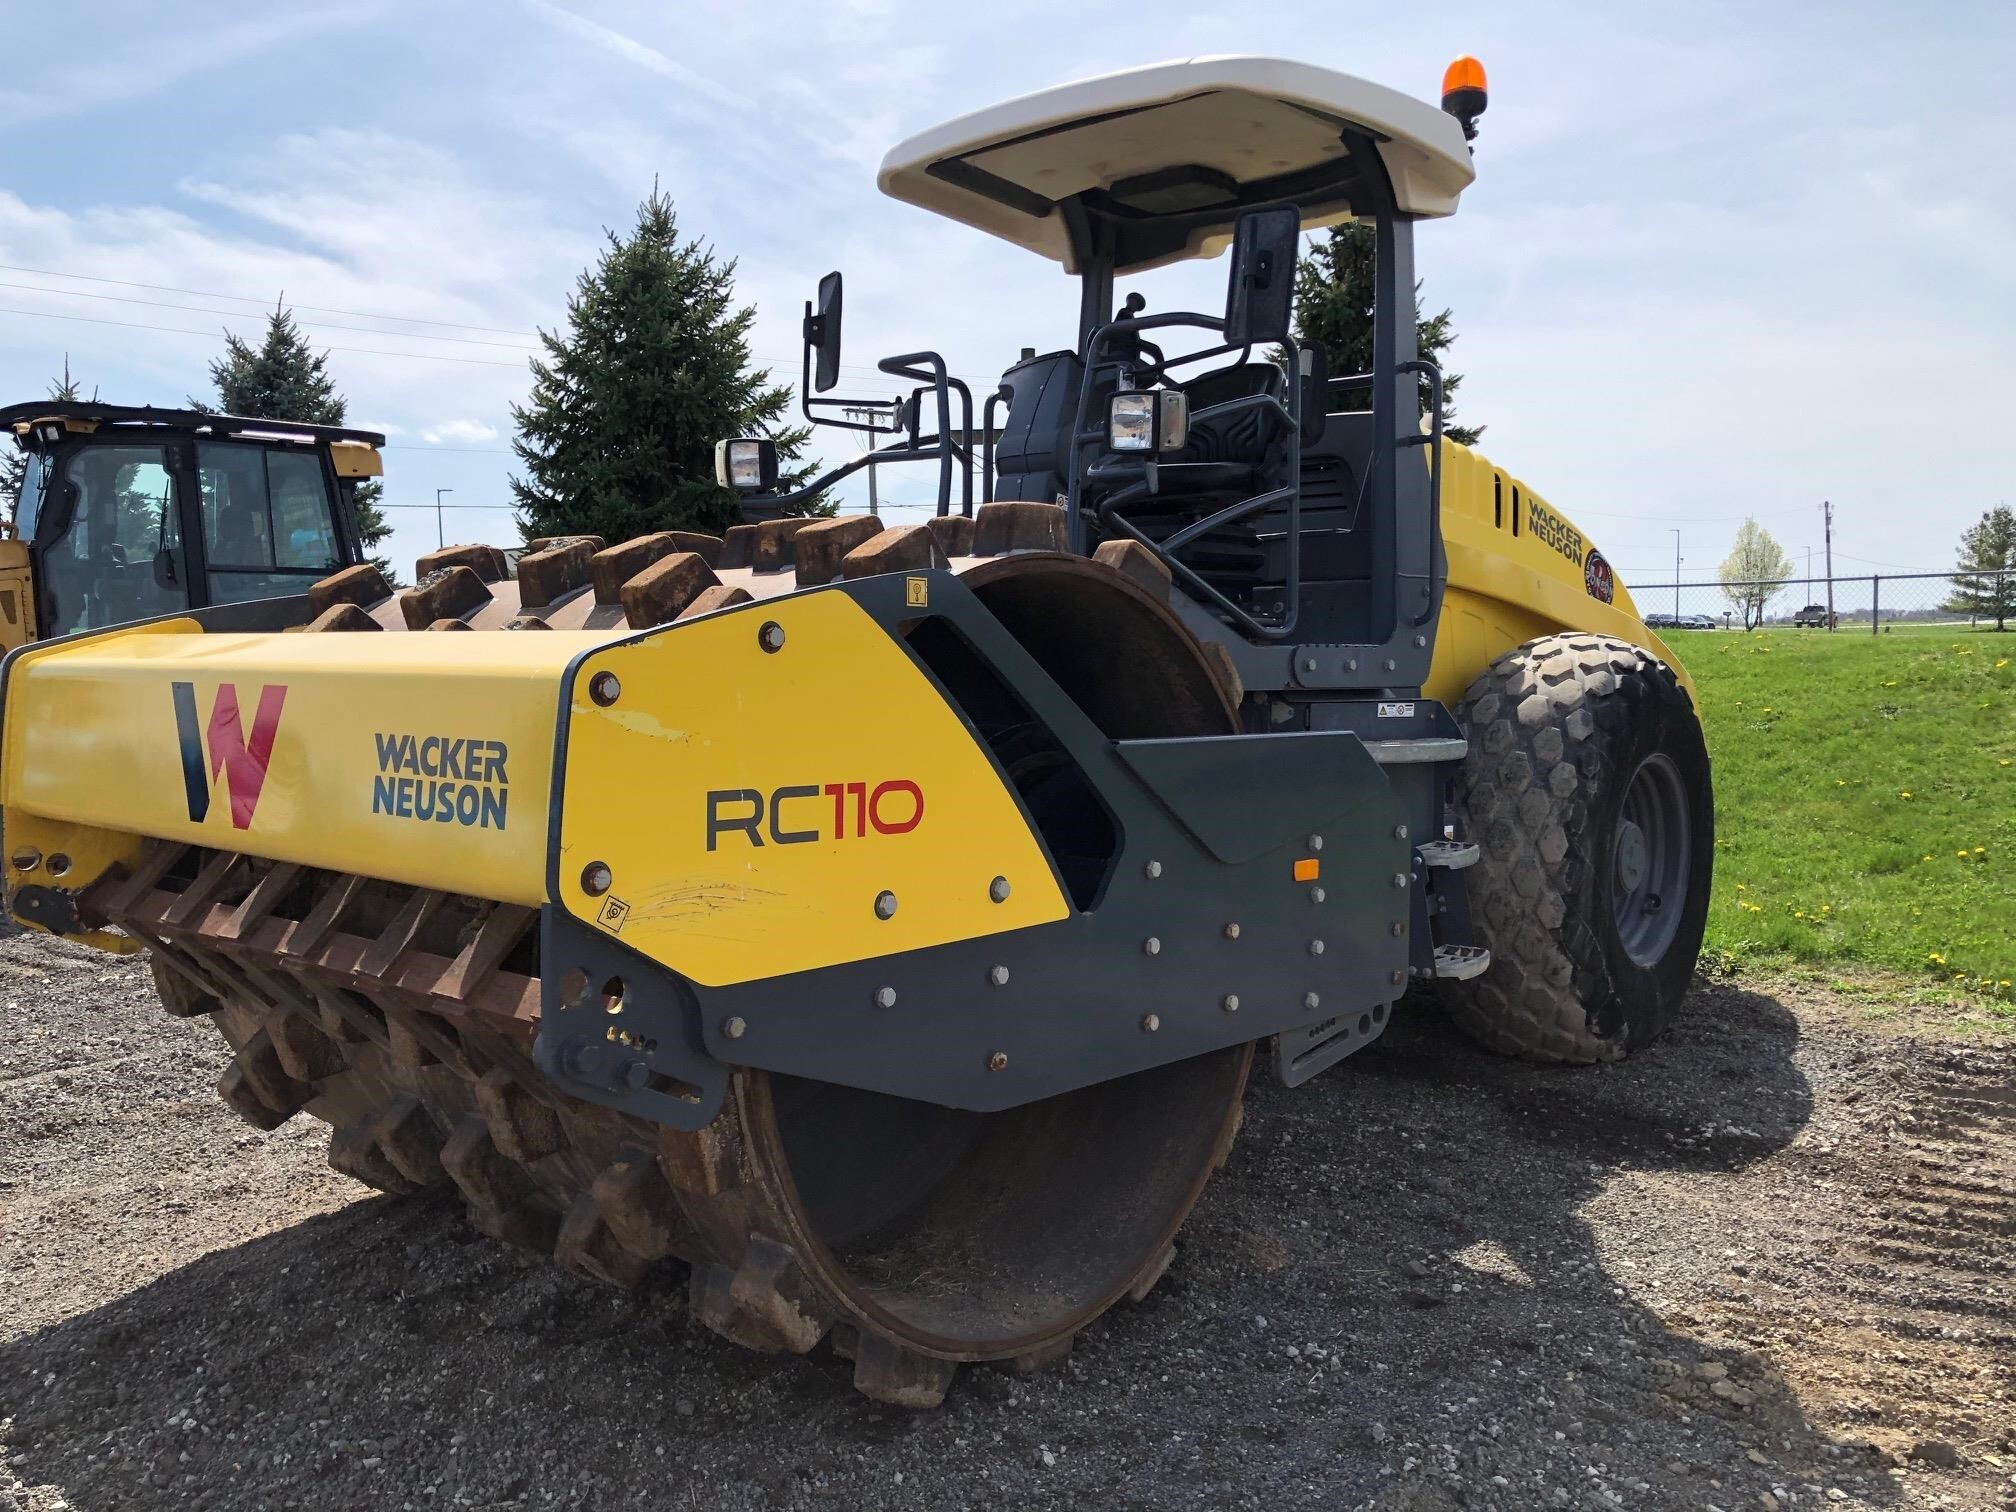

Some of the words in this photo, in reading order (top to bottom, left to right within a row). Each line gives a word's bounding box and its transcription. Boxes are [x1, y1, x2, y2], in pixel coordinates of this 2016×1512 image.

[1528, 498, 1582, 553] WACKER
[1528, 516, 1582, 569] NEUSON
[374, 732, 509, 784] WACKER
[372, 774, 508, 831] NEUSON
[706, 779, 924, 852] RC110
